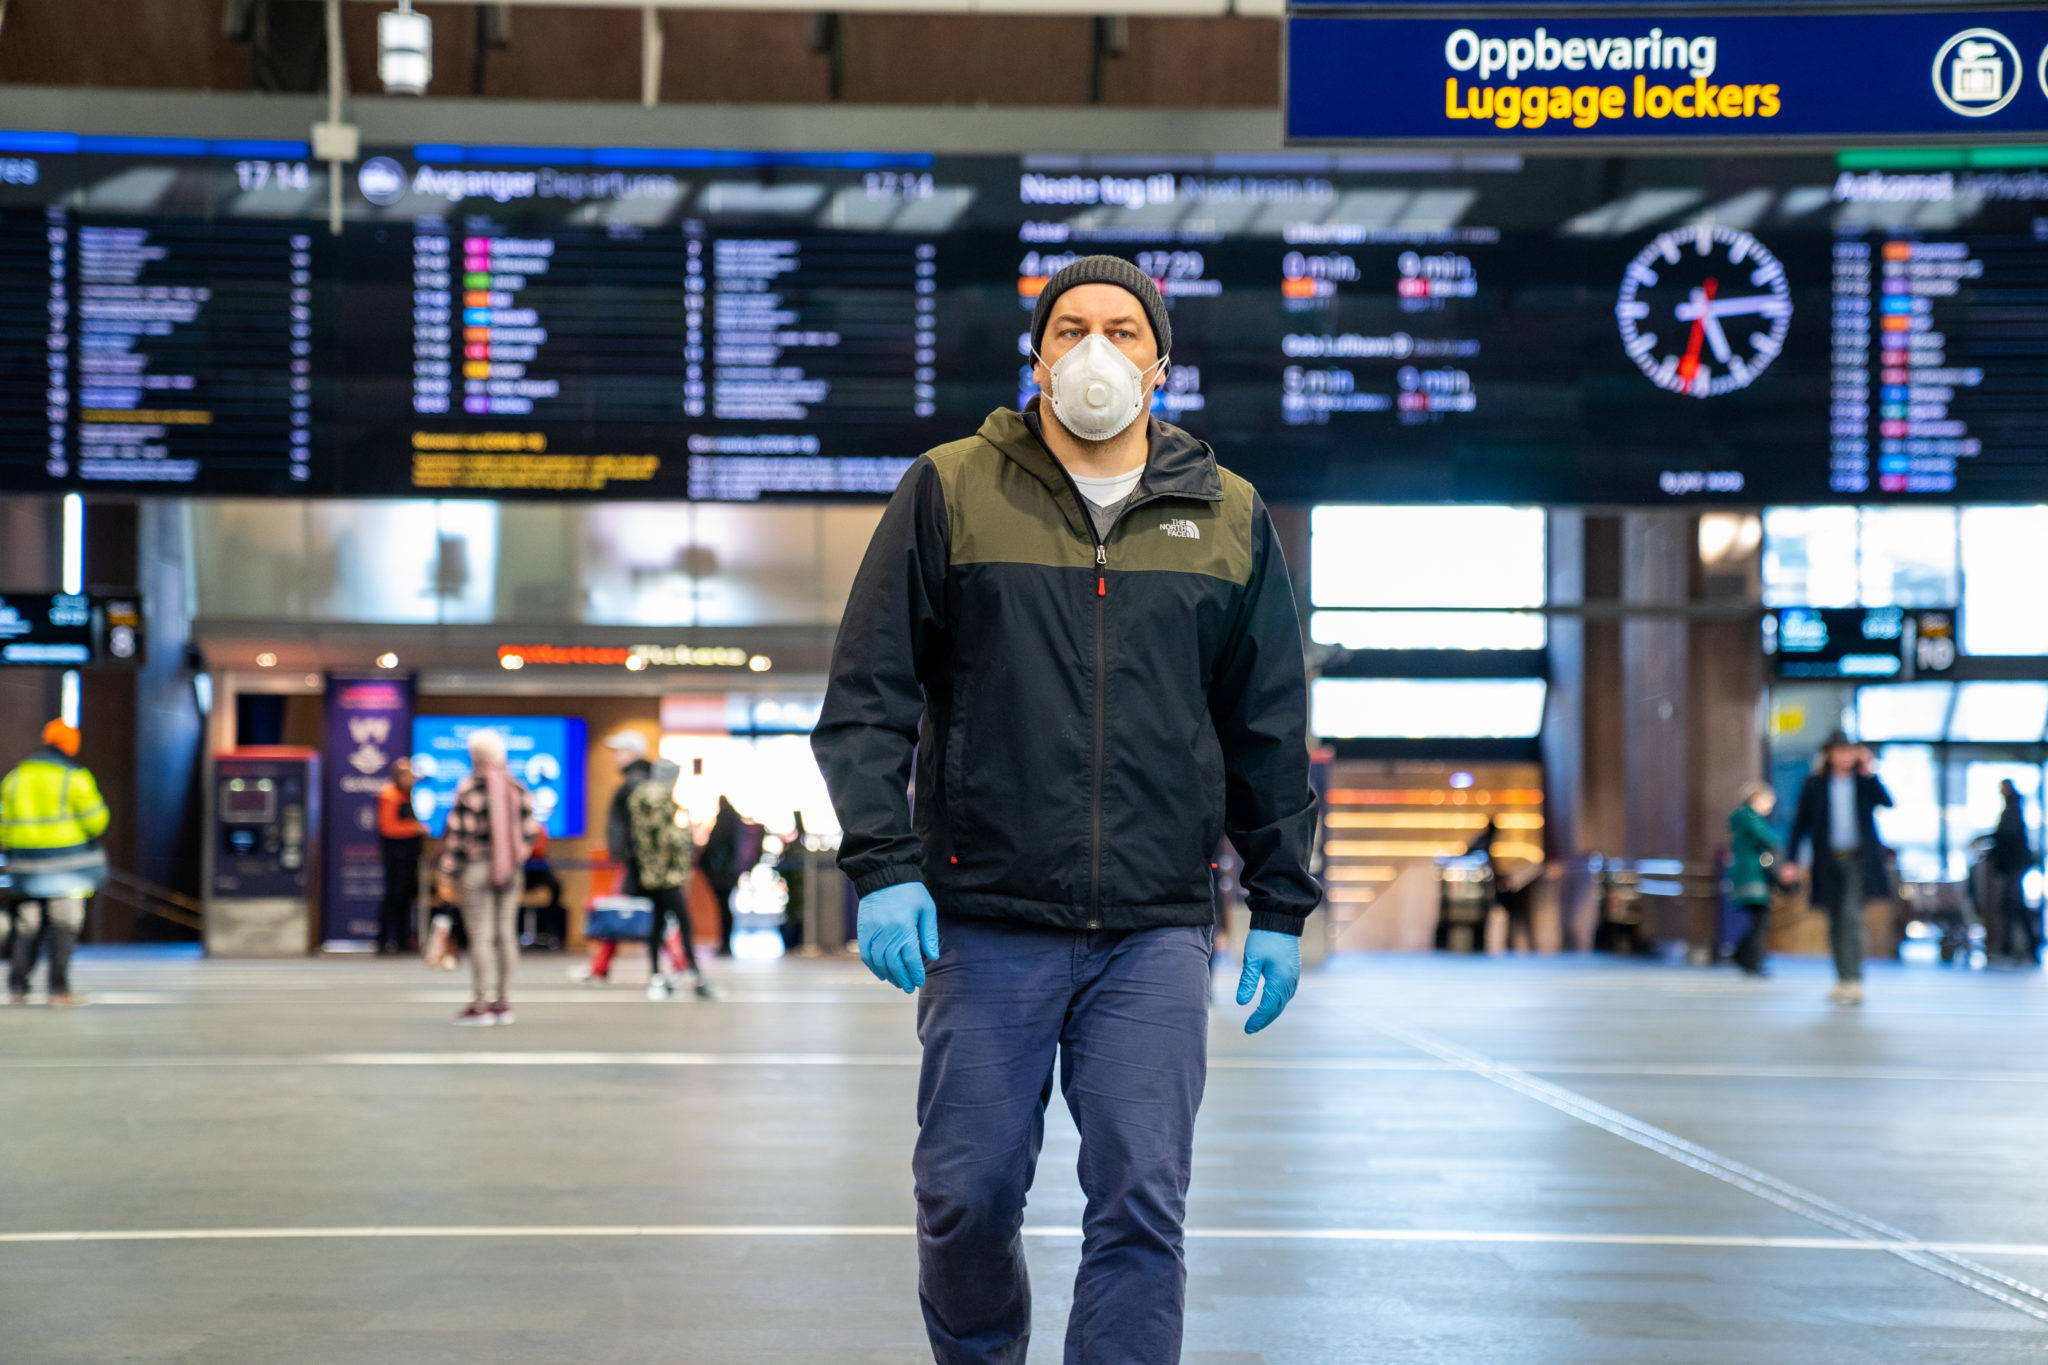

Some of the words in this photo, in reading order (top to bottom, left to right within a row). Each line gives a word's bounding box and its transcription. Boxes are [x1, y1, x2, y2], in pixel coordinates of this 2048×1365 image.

[1445, 27, 1717, 80] Oppbevaring
[1445, 77, 1626, 128] Luggage
[1633, 75, 1781, 118] lockers
[412, 165, 535, 202] Avganger
[1020, 173, 1099, 204] Neste
[1159, 523, 1187, 532] NORTH
[1168, 530, 1187, 538] FACE
[1171, 518, 1186, 526] THE
